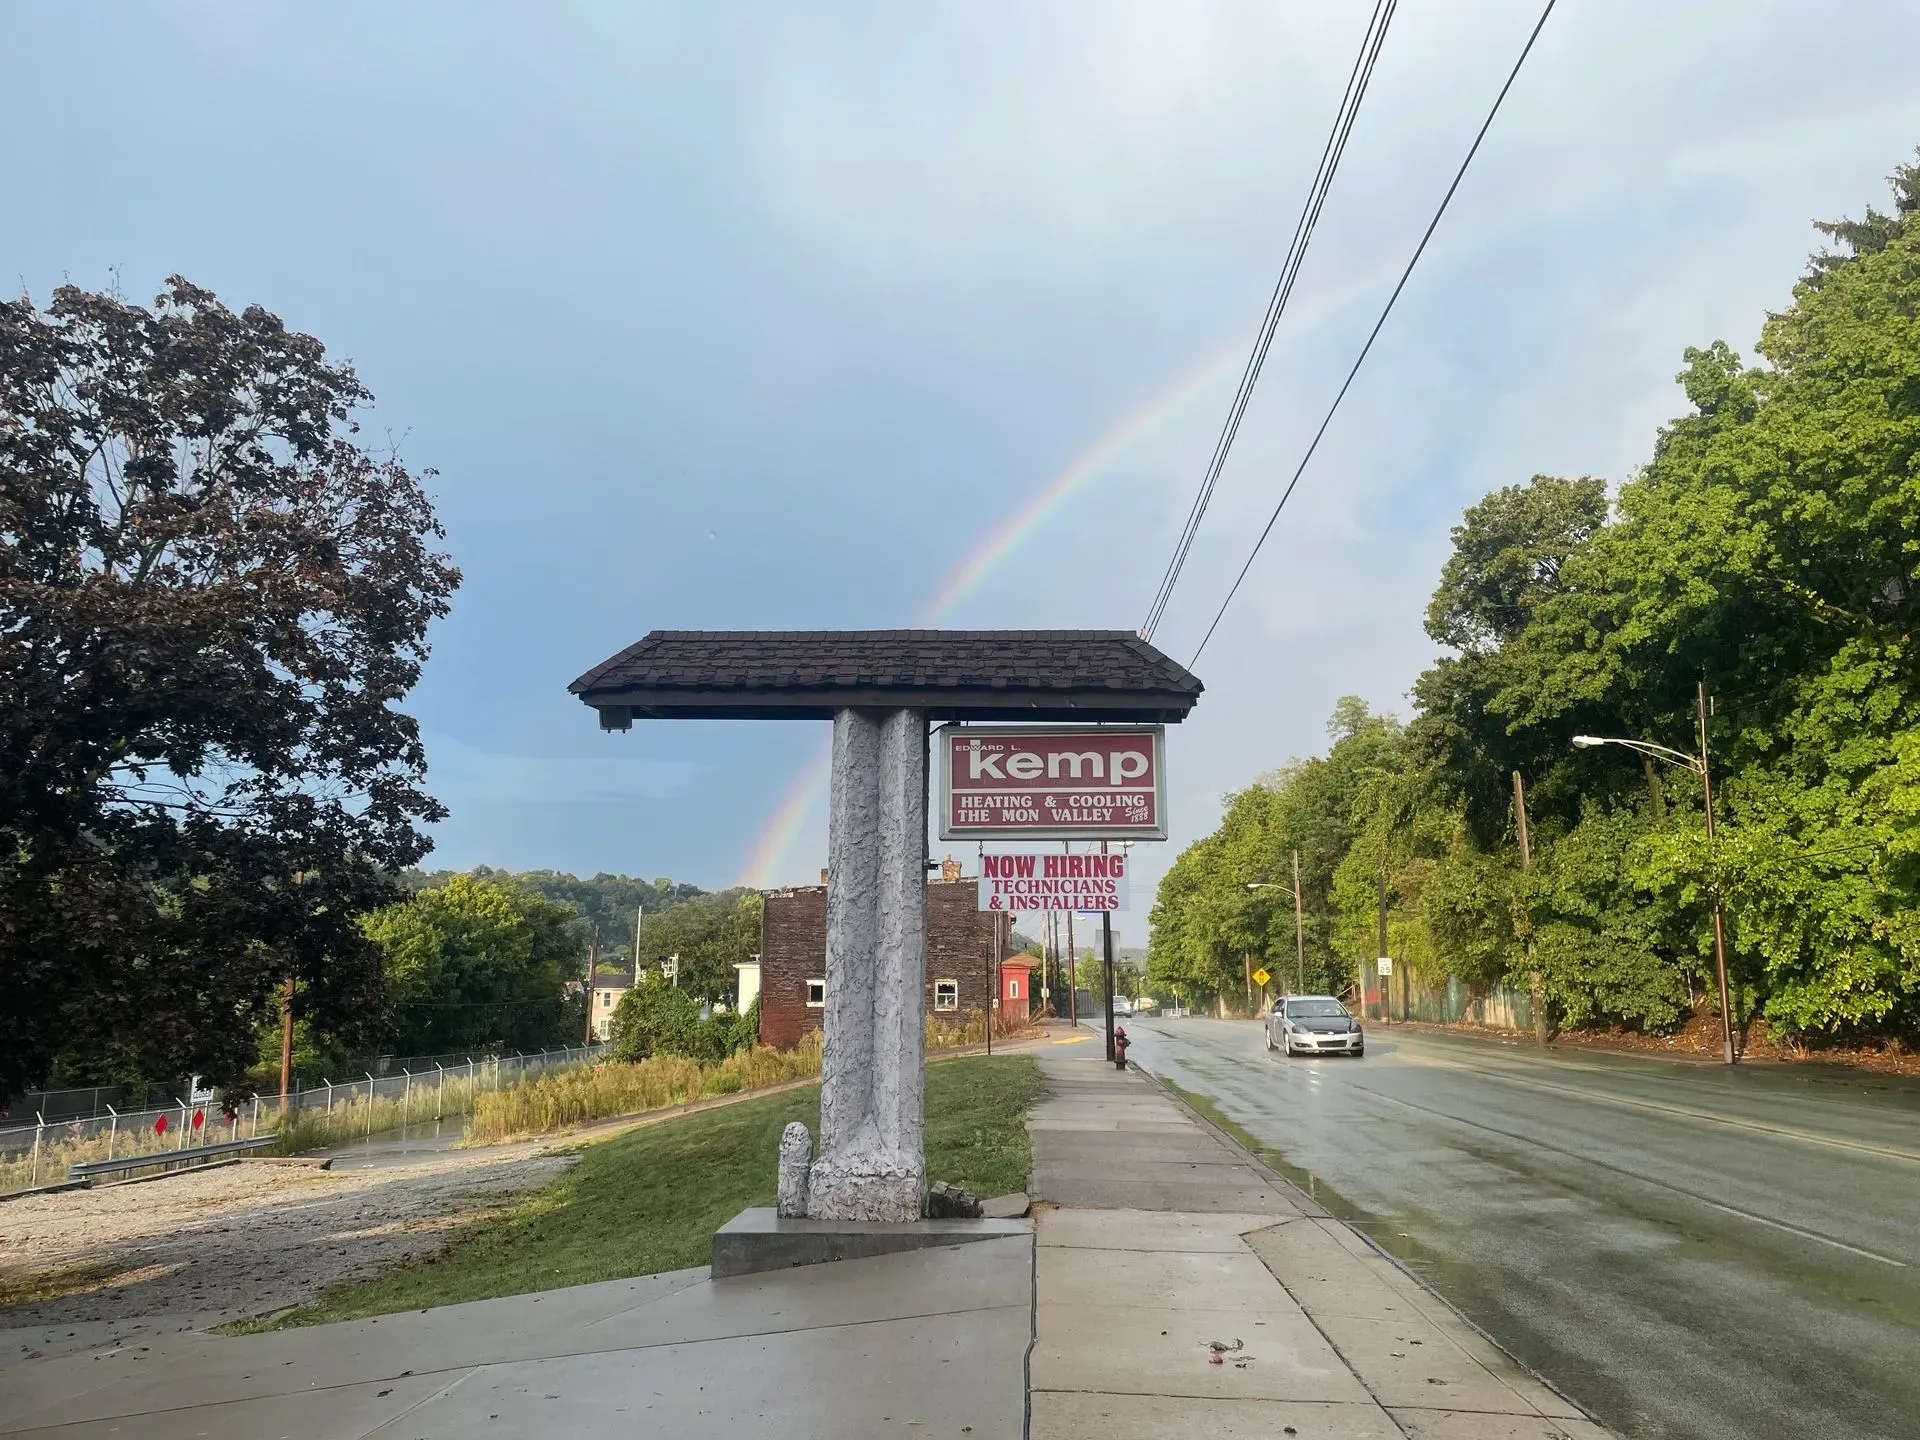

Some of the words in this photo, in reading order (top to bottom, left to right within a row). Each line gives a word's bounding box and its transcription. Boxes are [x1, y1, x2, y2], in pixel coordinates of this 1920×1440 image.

[970, 739, 1149, 785] kemp
[961, 795, 1033, 808] HEATING
[1044, 795, 1057, 807] &
[1069, 795, 1145, 807] COOLING
[958, 809, 990, 822] THE
[1002, 809, 1039, 822] MON
[1051, 809, 1113, 822] VALLEY
[1125, 805, 1149, 817] Since
[984, 855, 1036, 878] NOW
[1043, 855, 1124, 878] HIRING
[992, 879, 1116, 894] TECHNICIANS
[989, 895, 1003, 910] &
[1009, 895, 1119, 910] INSTALLERS
